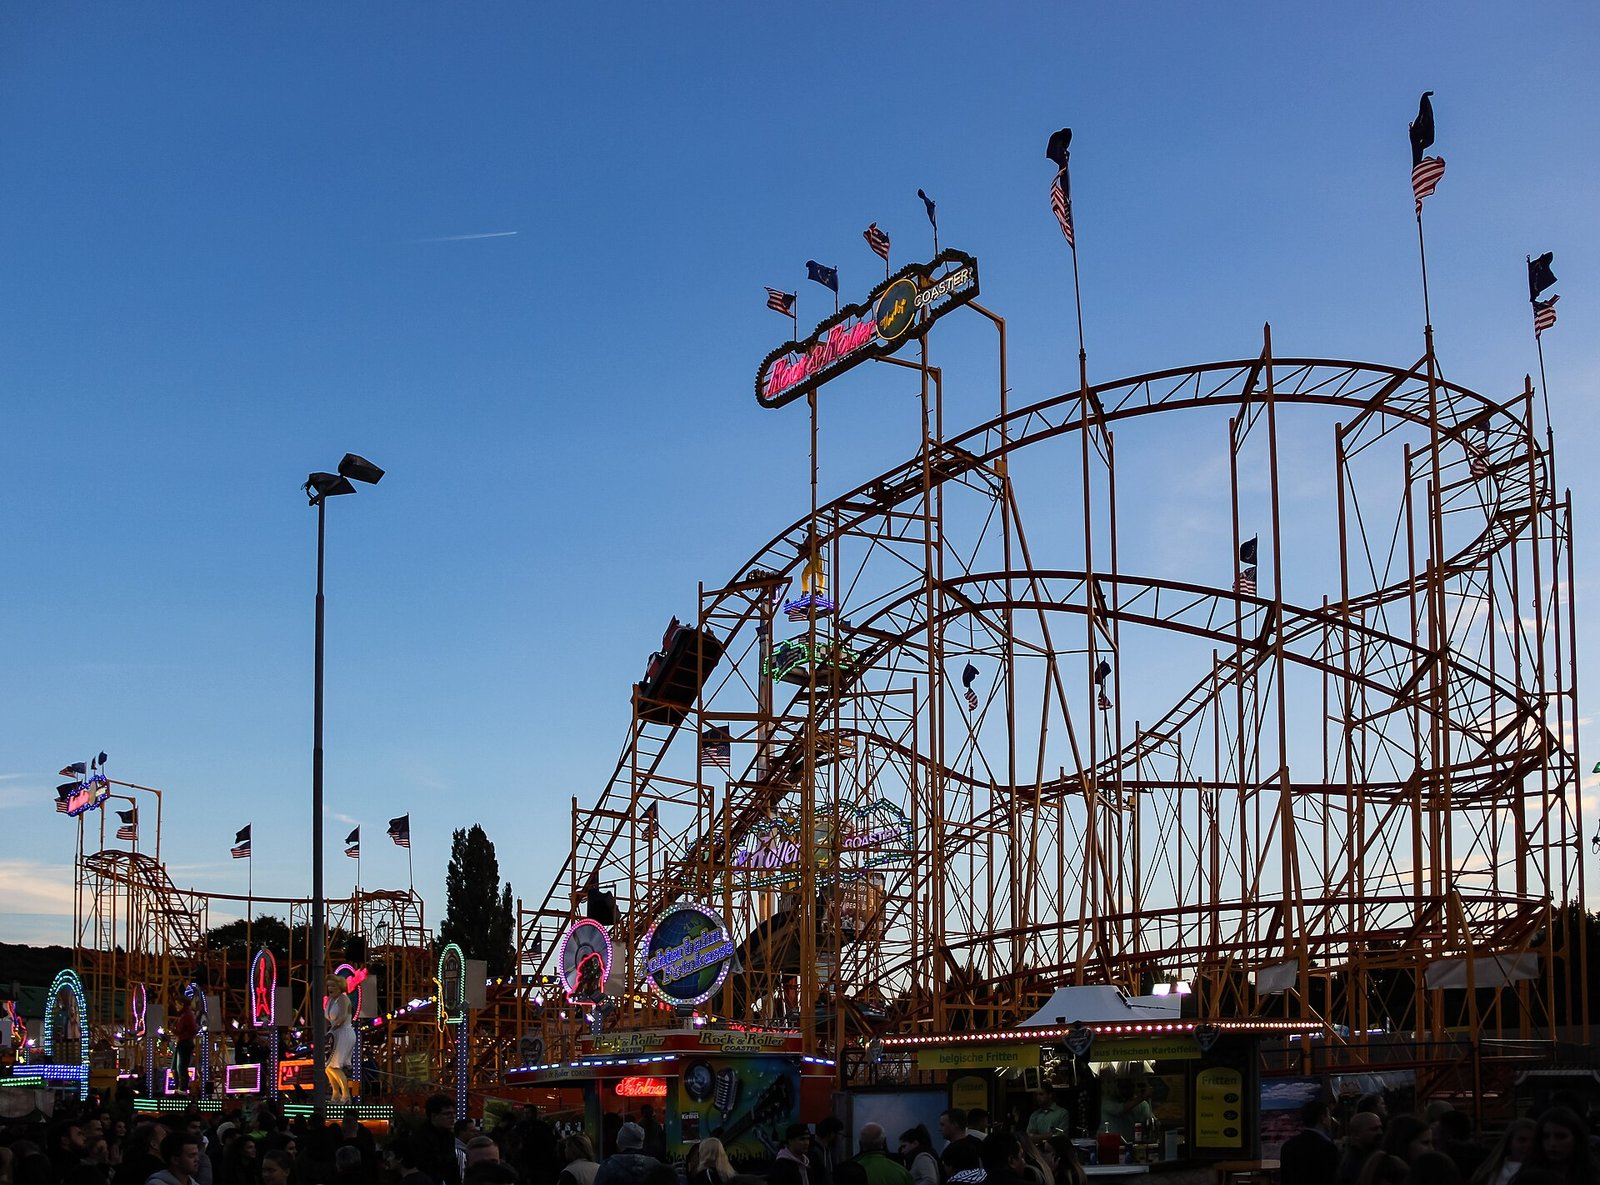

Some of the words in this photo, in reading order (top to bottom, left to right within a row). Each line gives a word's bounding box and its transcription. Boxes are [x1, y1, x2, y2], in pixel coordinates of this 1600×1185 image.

[914, 267, 969, 308] COASTER
[764, 355, 808, 398] Rock
[819, 320, 876, 366] Roller
[630, 1034, 664, 1046] Roller
[700, 1032, 735, 1045] Rock
[745, 1033, 784, 1046] Roller
[939, 1053, 983, 1065] belgische
[986, 1051, 1018, 1062] Fritten
[1112, 1047, 1149, 1056] frischen
[1202, 1075, 1237, 1086] Fritten
